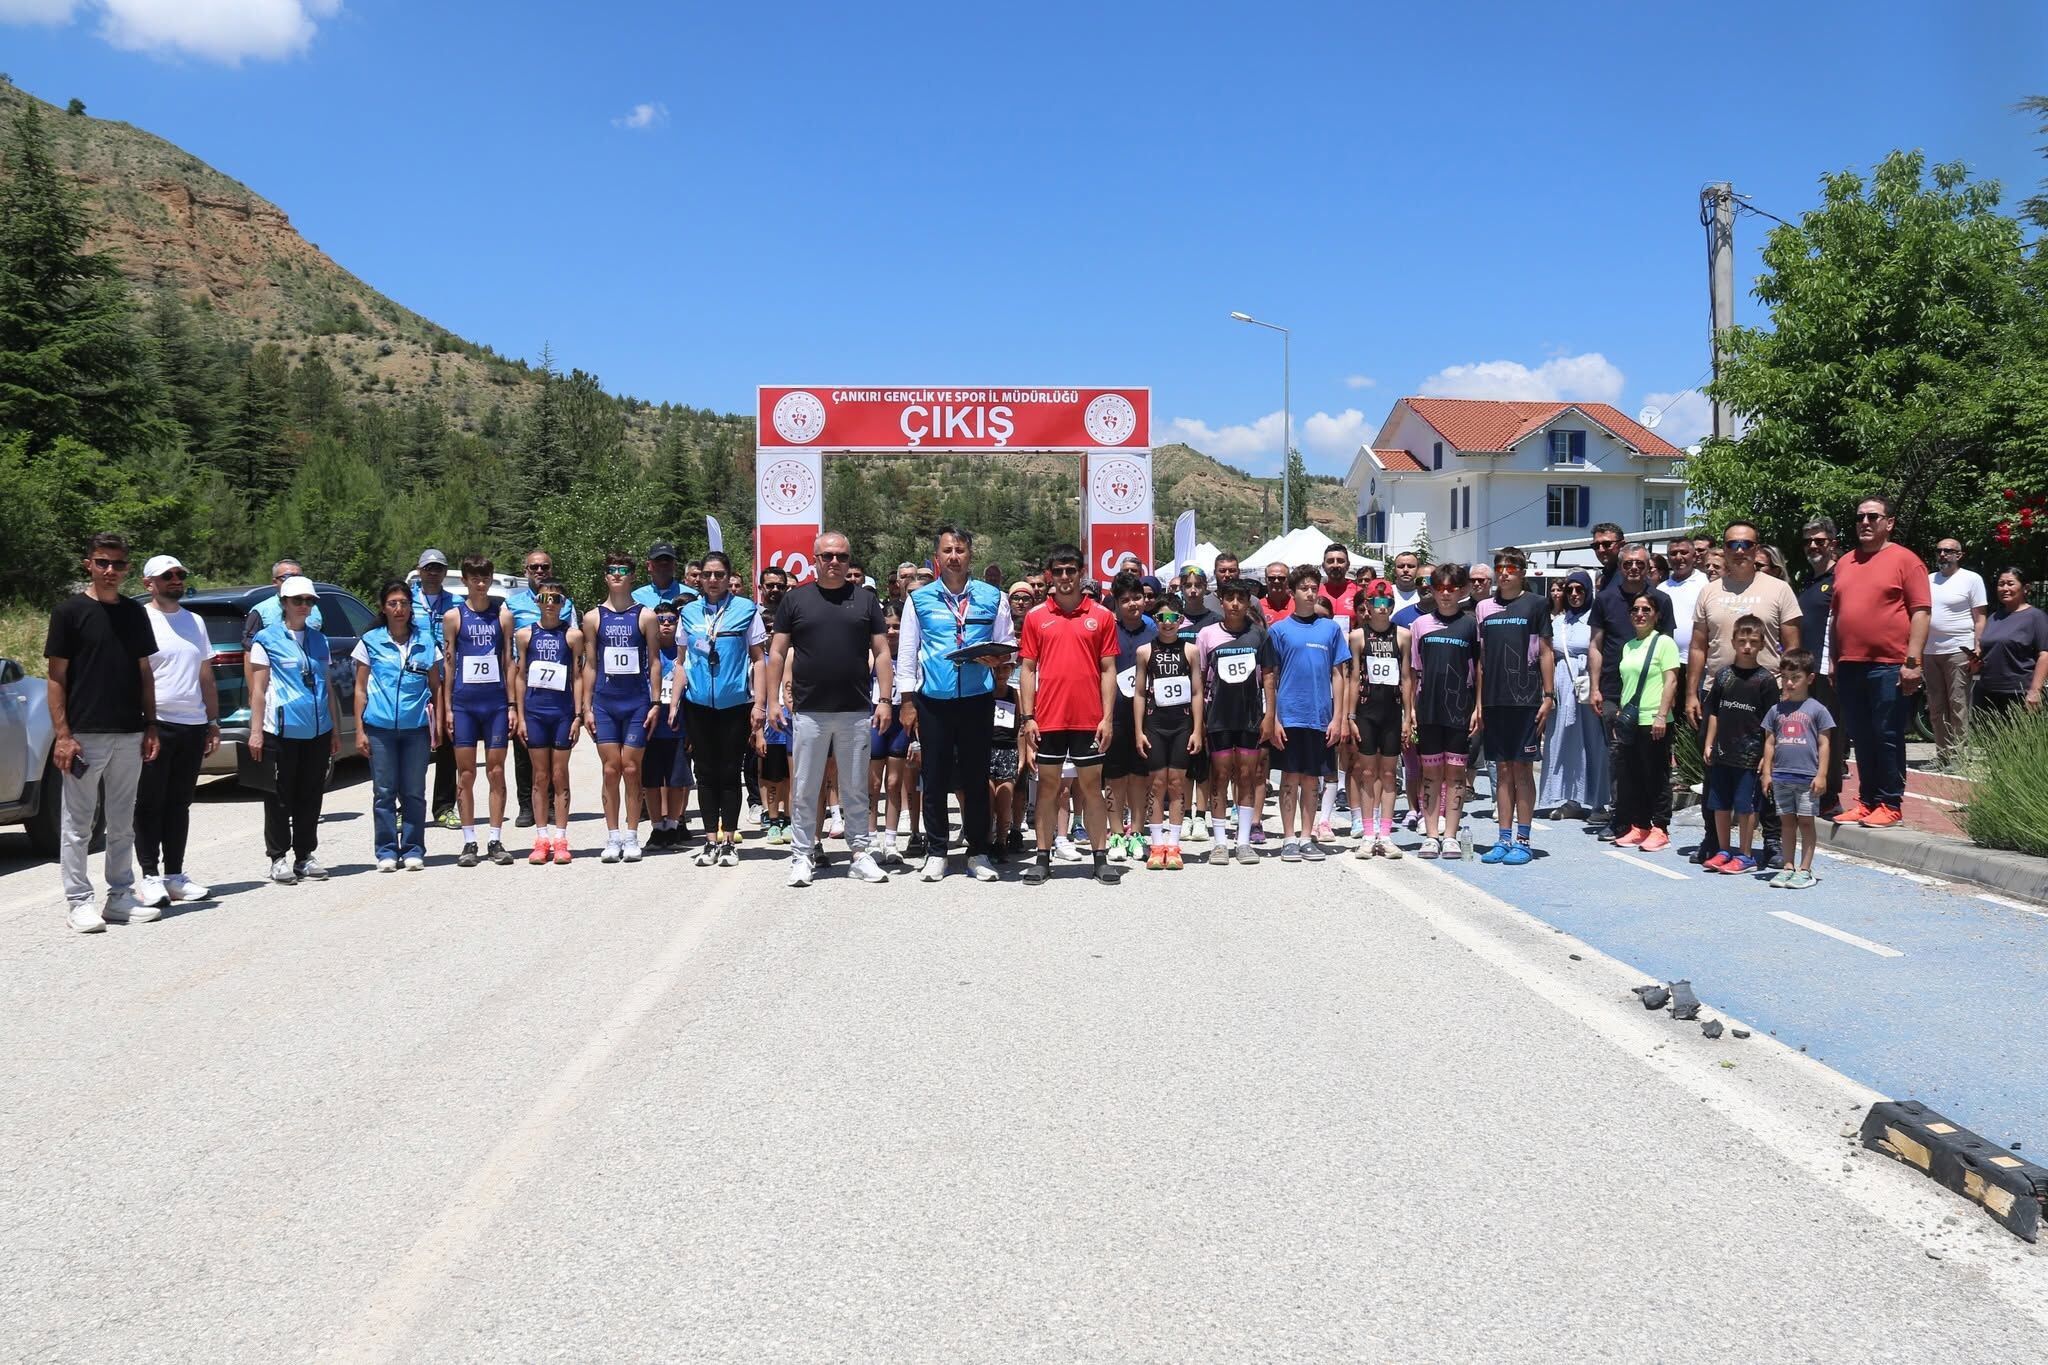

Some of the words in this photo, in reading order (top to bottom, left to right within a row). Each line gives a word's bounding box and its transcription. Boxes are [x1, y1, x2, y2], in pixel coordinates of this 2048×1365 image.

[832, 391, 881, 405] ÇANKIRI
[884, 389, 934, 405] GENÇLİK
[938, 391, 952, 402] VE
[955, 391, 986, 403] SPOR
[989, 389, 999, 403] İL
[1002, 389, 1079, 404] MÜDÜRLÜĞÜ
[900, 405, 1015, 447] ÇIKIŞ
[467, 624, 496, 636] YILMAN
[605, 625, 632, 636] SARIOGLU
[471, 635, 493, 646] TUR
[608, 636, 630, 647] TUR
[537, 649, 557, 661] TUR
[614, 654, 629, 666] 10
[1155, 653, 1181, 664] ŞEN
[473, 663, 490, 675] 78
[540, 668, 556, 682] 77
[1158, 663, 1179, 675] TUR
[1228, 662, 1247, 676] 85
[1372, 664, 1390, 677] 88
[1163, 684, 1182, 698] 39
